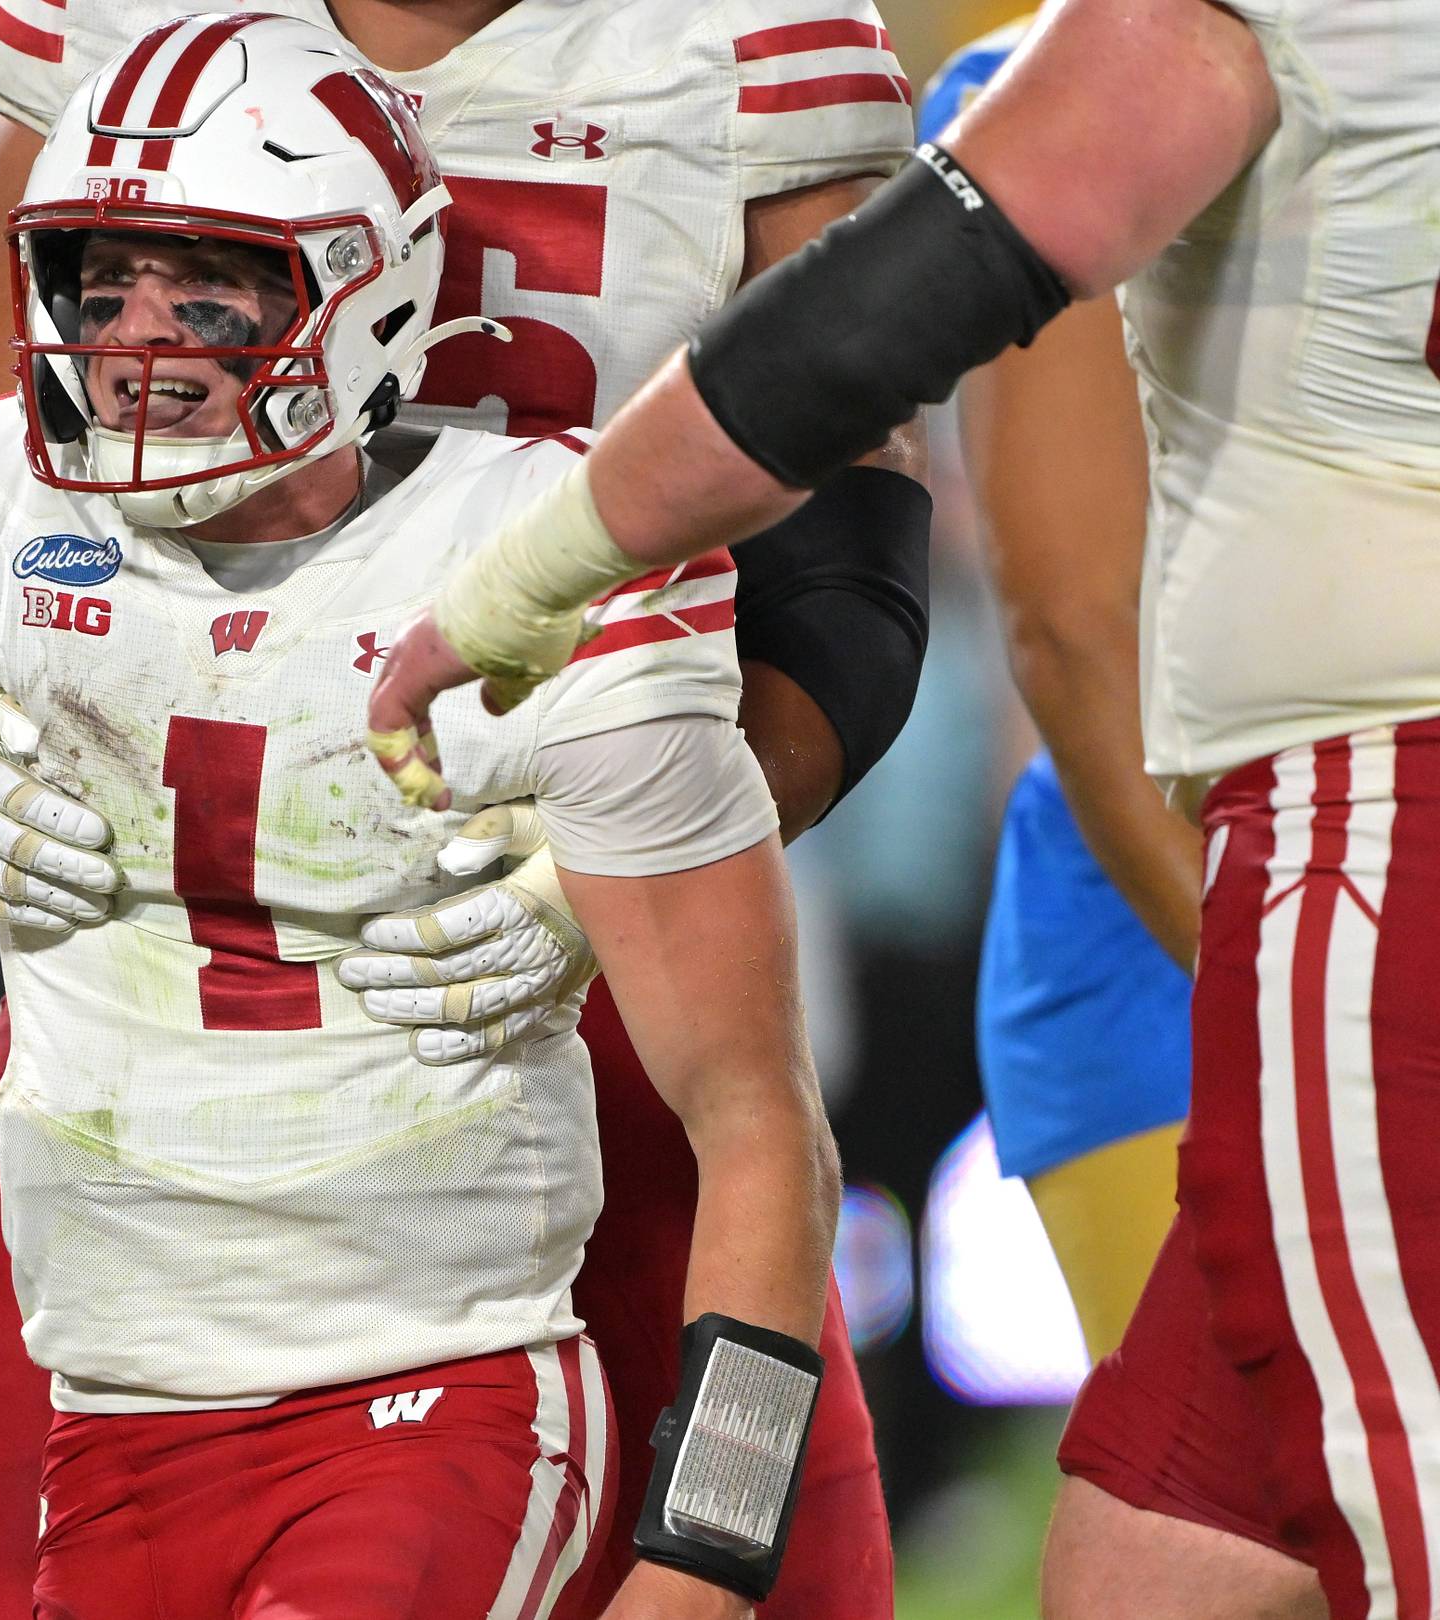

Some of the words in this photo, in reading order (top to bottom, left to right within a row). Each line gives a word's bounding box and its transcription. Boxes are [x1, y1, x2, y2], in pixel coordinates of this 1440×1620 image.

[14, 537, 120, 578] Culver's
[209, 610, 270, 657] W
[162, 715, 322, 1030] 1
[368, 1386, 445, 1430] W
